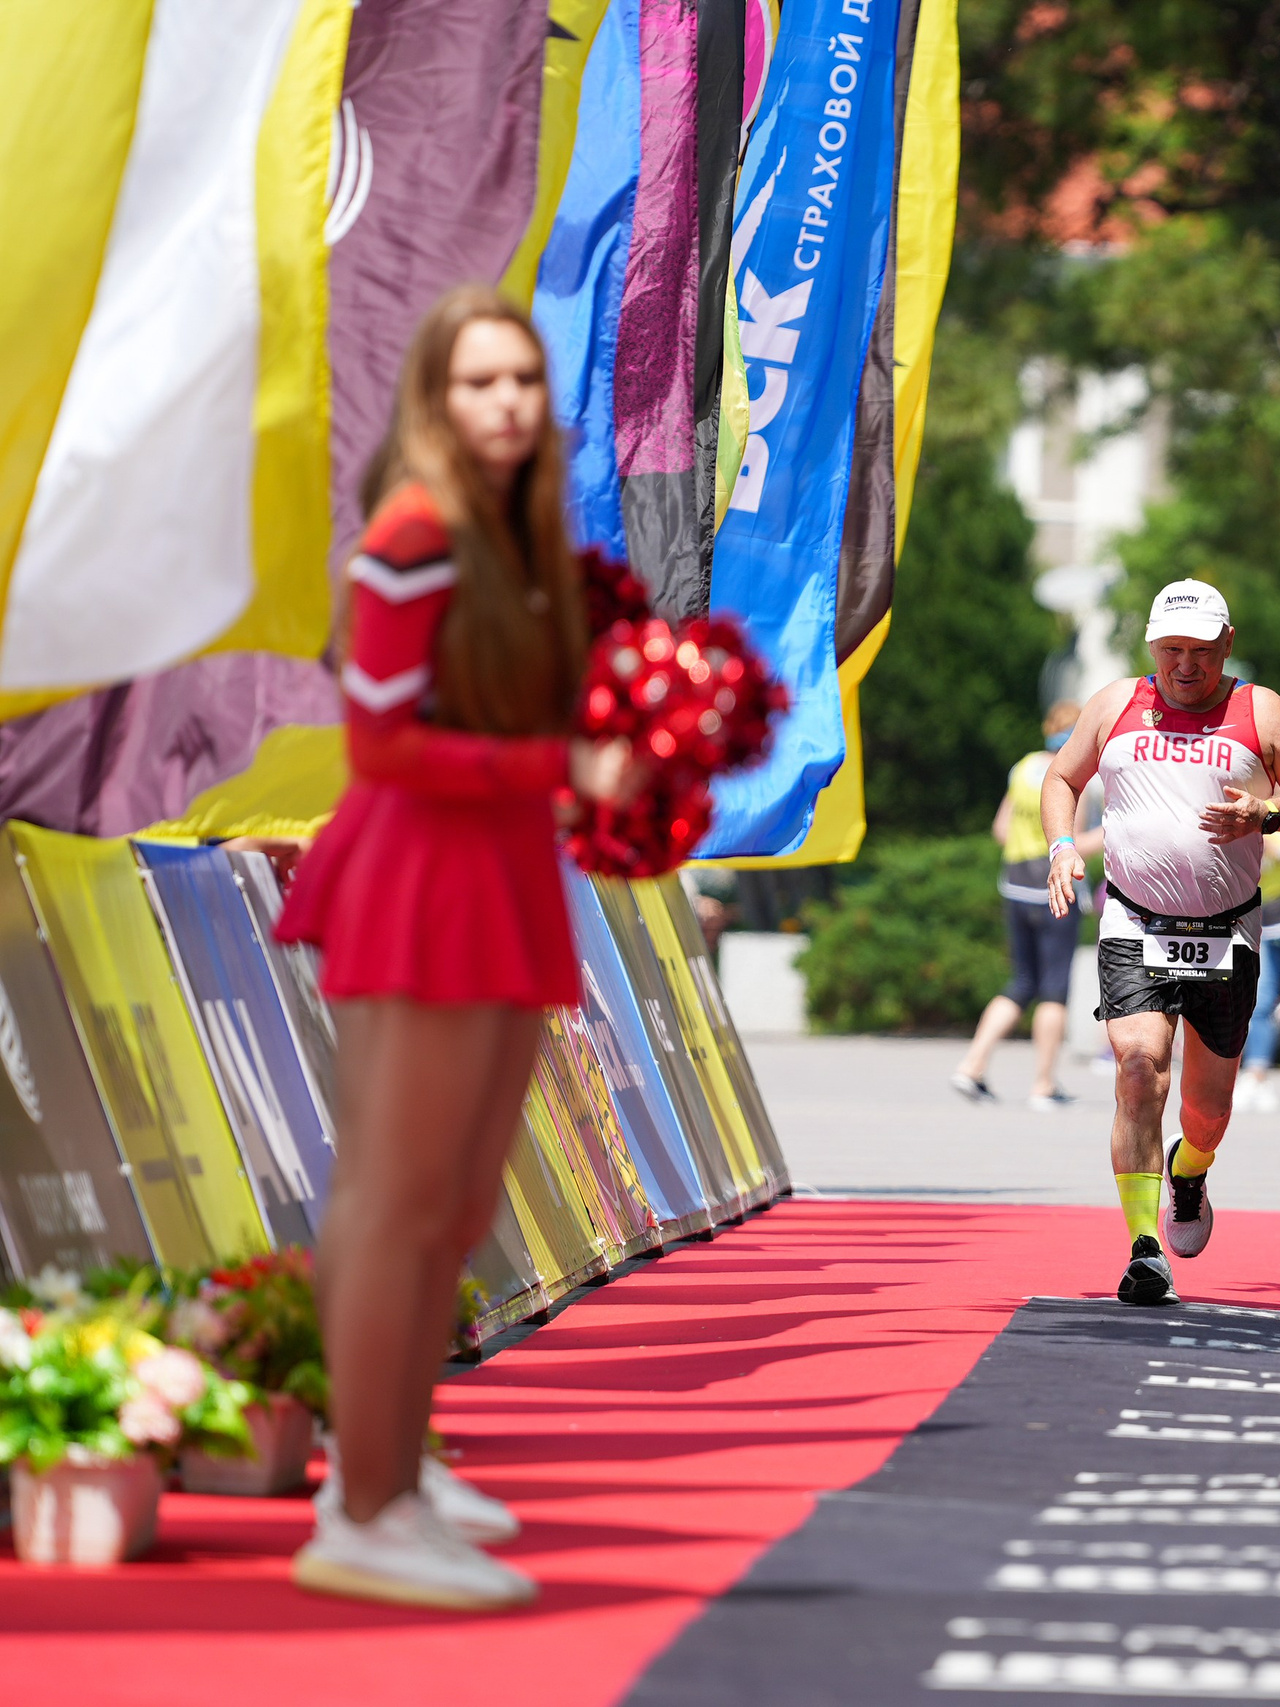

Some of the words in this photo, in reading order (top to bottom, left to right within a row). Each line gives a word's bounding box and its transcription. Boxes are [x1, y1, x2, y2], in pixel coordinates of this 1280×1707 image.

[793, 32, 864, 271] СТРАХОВОЙ
[729, 266, 814, 513] ВСК
[1164, 595, 1200, 605] Amway
[1133, 735, 1232, 772] RUSSIA
[1166, 940, 1210, 964] 303
[1167, 968, 1207, 977] VYACHESLAV
